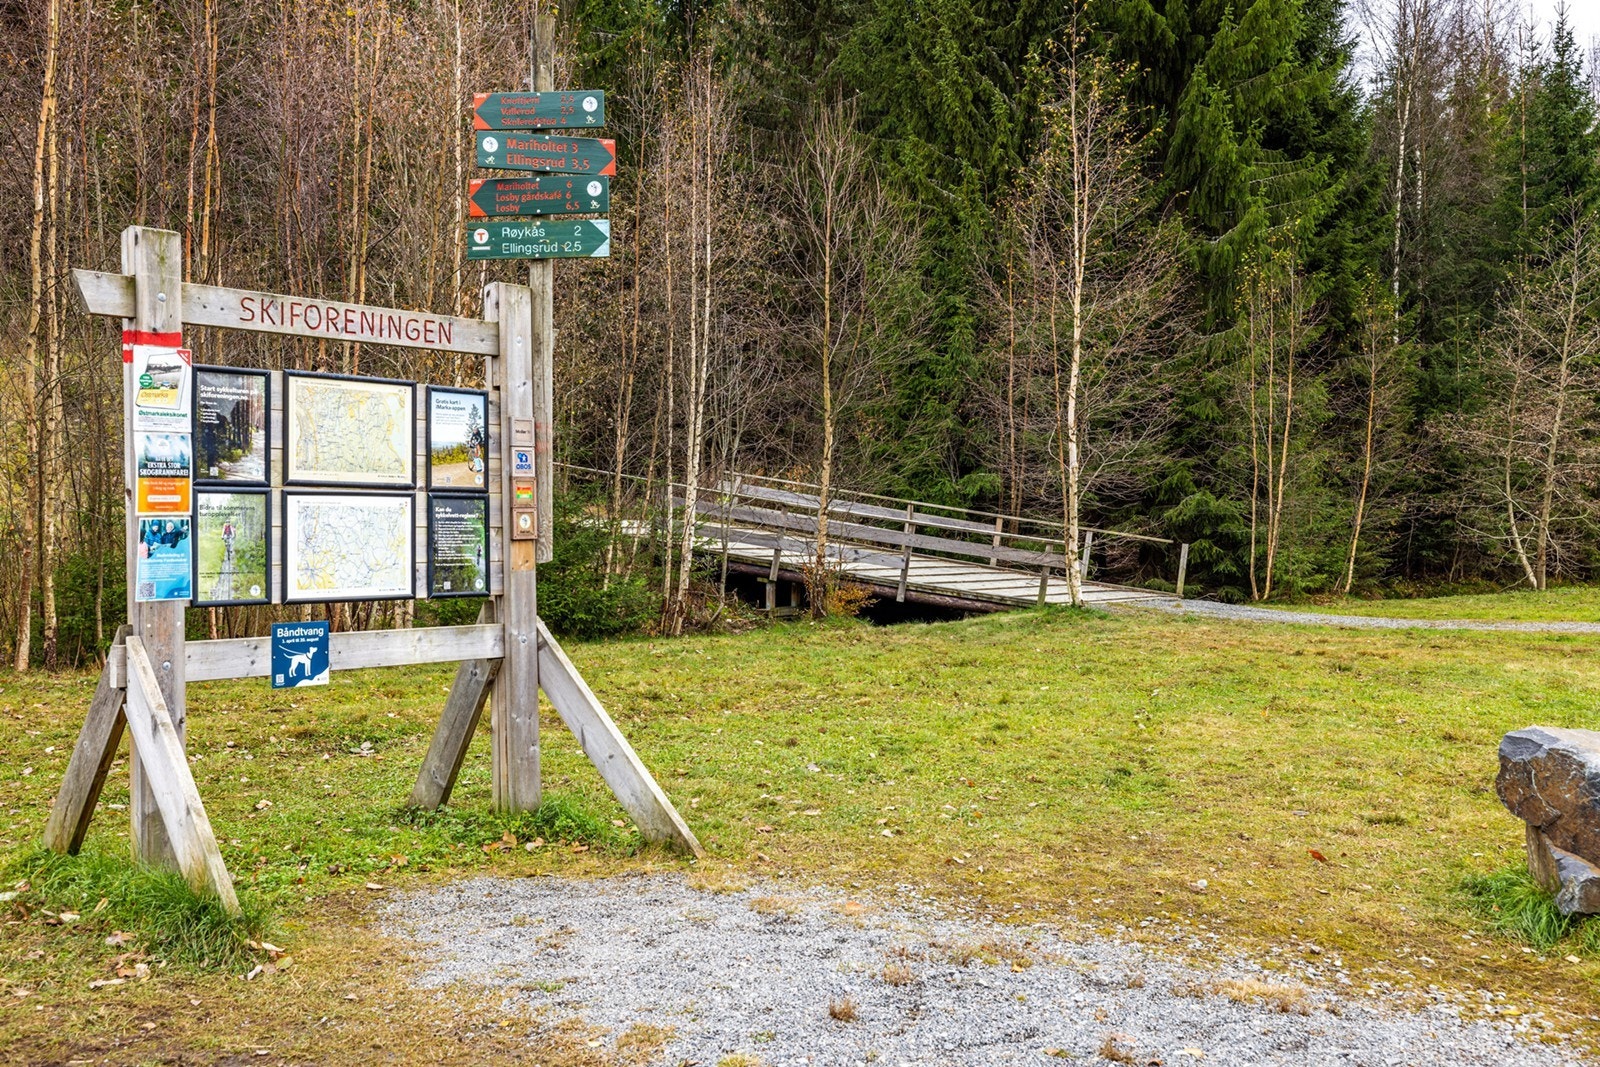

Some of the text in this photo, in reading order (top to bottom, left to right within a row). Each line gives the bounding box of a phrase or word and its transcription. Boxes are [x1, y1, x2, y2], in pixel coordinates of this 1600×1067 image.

[560, 95, 575, 103] 2,5
[560, 106, 575, 115] 2,5
[506, 138, 579, 153] Mariholtet 3
[506, 153, 591, 170] Ellingsrud 3,5
[496, 180, 573, 191] Mariholtet 6
[495, 190, 572, 203] Losby gårdskafé 6
[495, 201, 580, 214] Losby 6,5
[501, 225, 582, 239] Røykås 2
[502, 242, 558, 255] Ellingsrud
[238, 297, 453, 344] SKIFORENINGEN
[277, 627, 324, 637] Båndtvang
